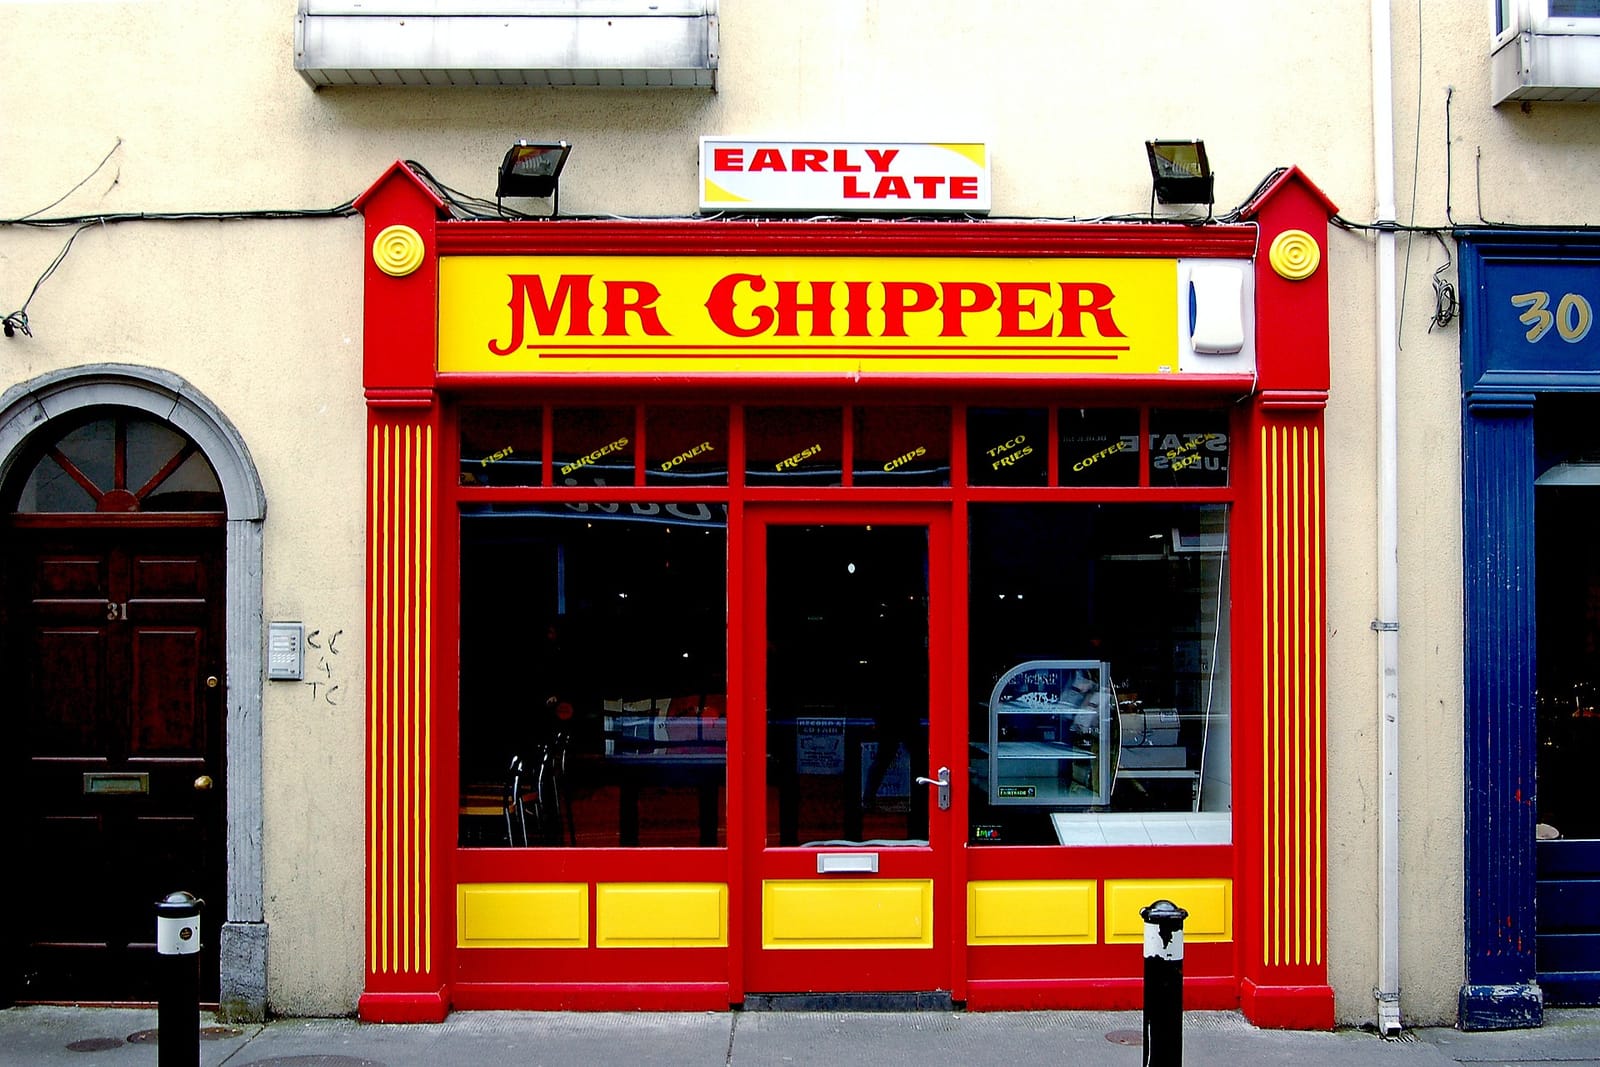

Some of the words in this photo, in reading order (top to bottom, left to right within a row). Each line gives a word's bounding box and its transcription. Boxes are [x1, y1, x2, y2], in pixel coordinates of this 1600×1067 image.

[714, 148, 899, 172] EARLY
[843, 176, 978, 199] LATE
[488, 274, 673, 356] MR
[704, 273, 1128, 338] CHIPPER
[1511, 291, 1593, 343] 30
[480, 446, 514, 467] FISH
[560, 437, 629, 475] BURGERS
[661, 441, 714, 472] DONER
[775, 444, 822, 472] FRESH
[987, 435, 1026, 457] TACO
[992, 446, 1034, 470] FRIES
[1073, 441, 1127, 472] COFFEE
[883, 446, 927, 472] CHIPS
[1172, 452, 1201, 471] BOX
[107, 602, 128, 620] 31
